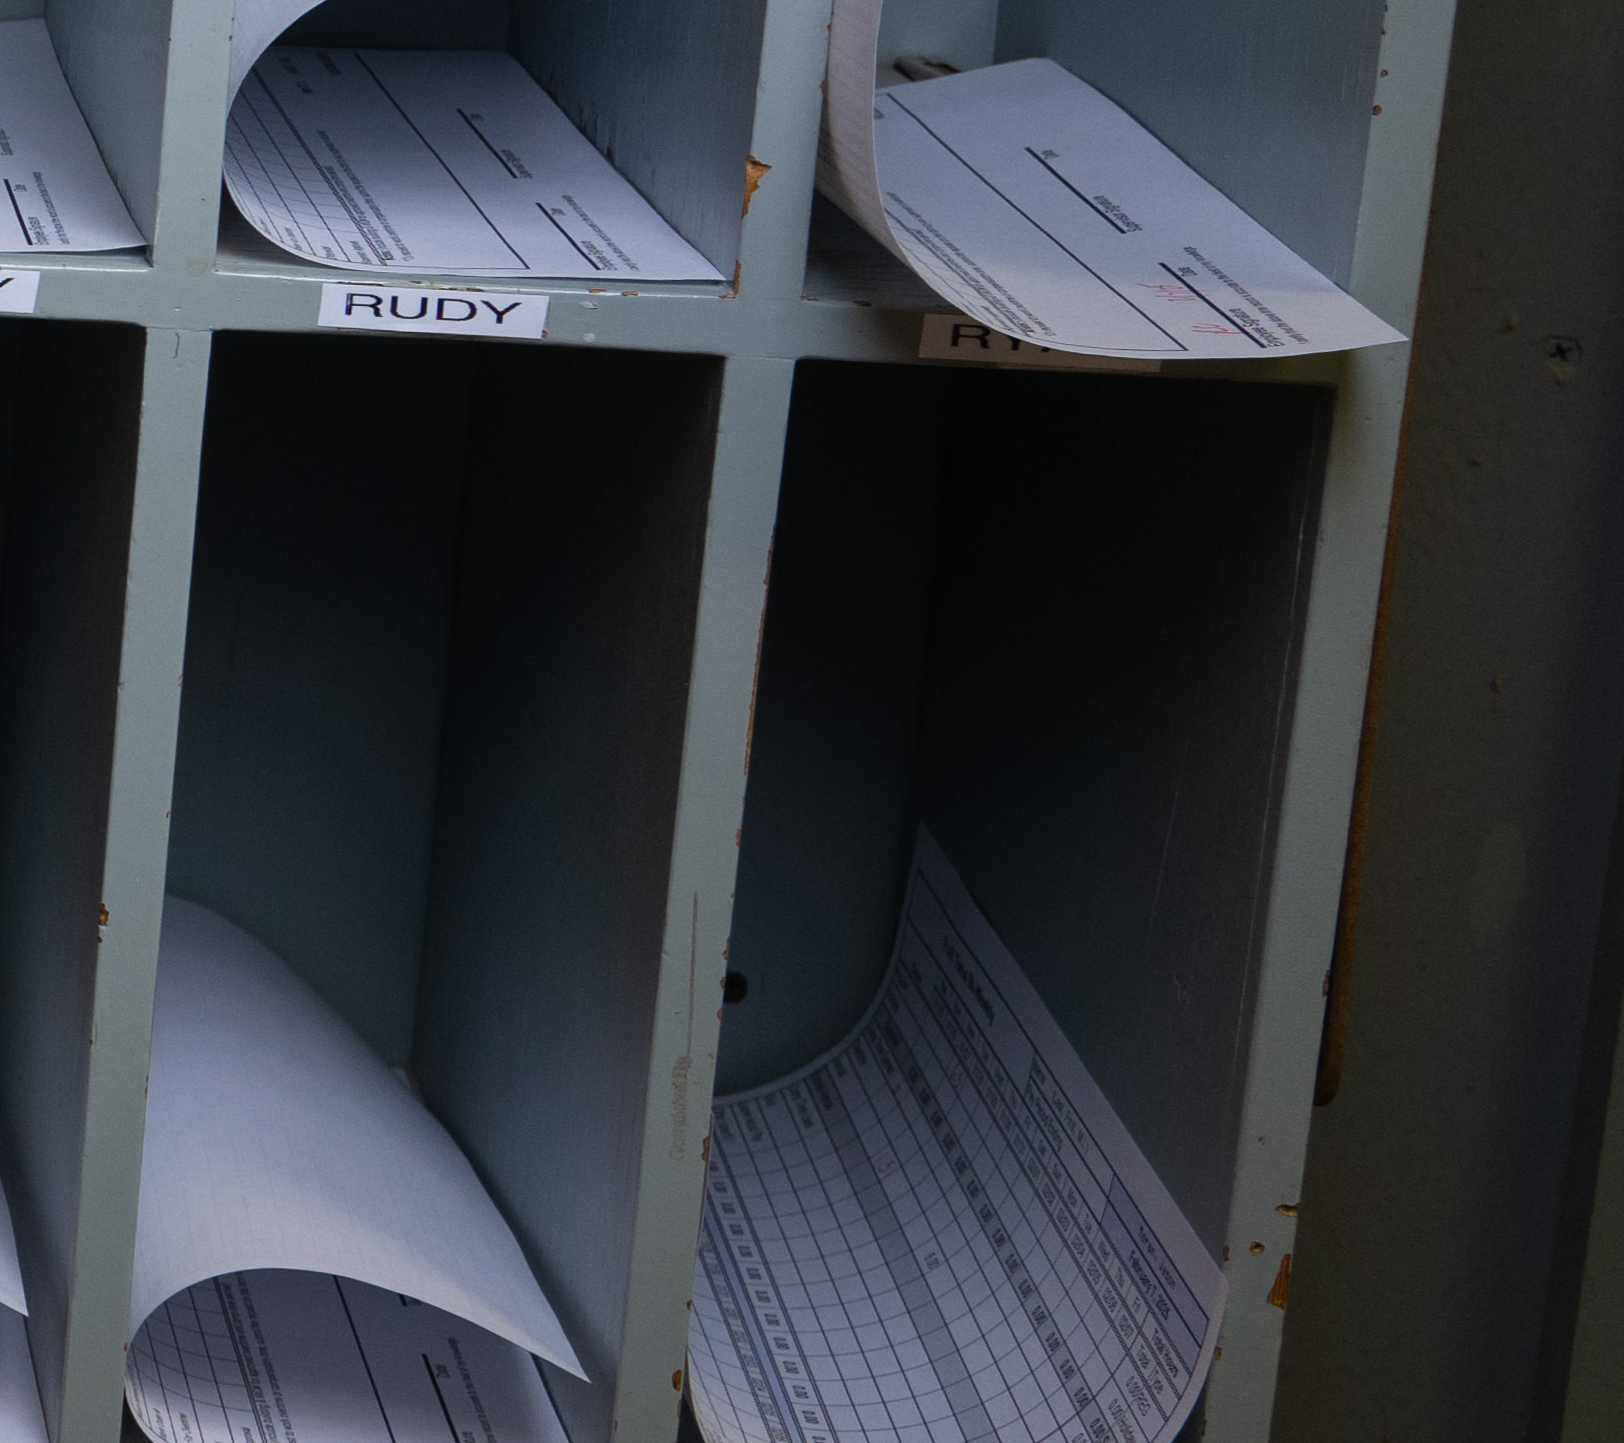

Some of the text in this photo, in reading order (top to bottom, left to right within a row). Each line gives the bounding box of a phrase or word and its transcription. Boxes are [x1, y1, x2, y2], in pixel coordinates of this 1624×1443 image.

[345, 293, 522, 326] RUDY
[432, 1363, 451, 1378] Date
[1132, 1345, 1153, 1370] Total
[1145, 1370, 1167, 1396] Type
[1105, 1398, 1125, 1419] 0.00
[1086, 1417, 1107, 1439] 0.00
